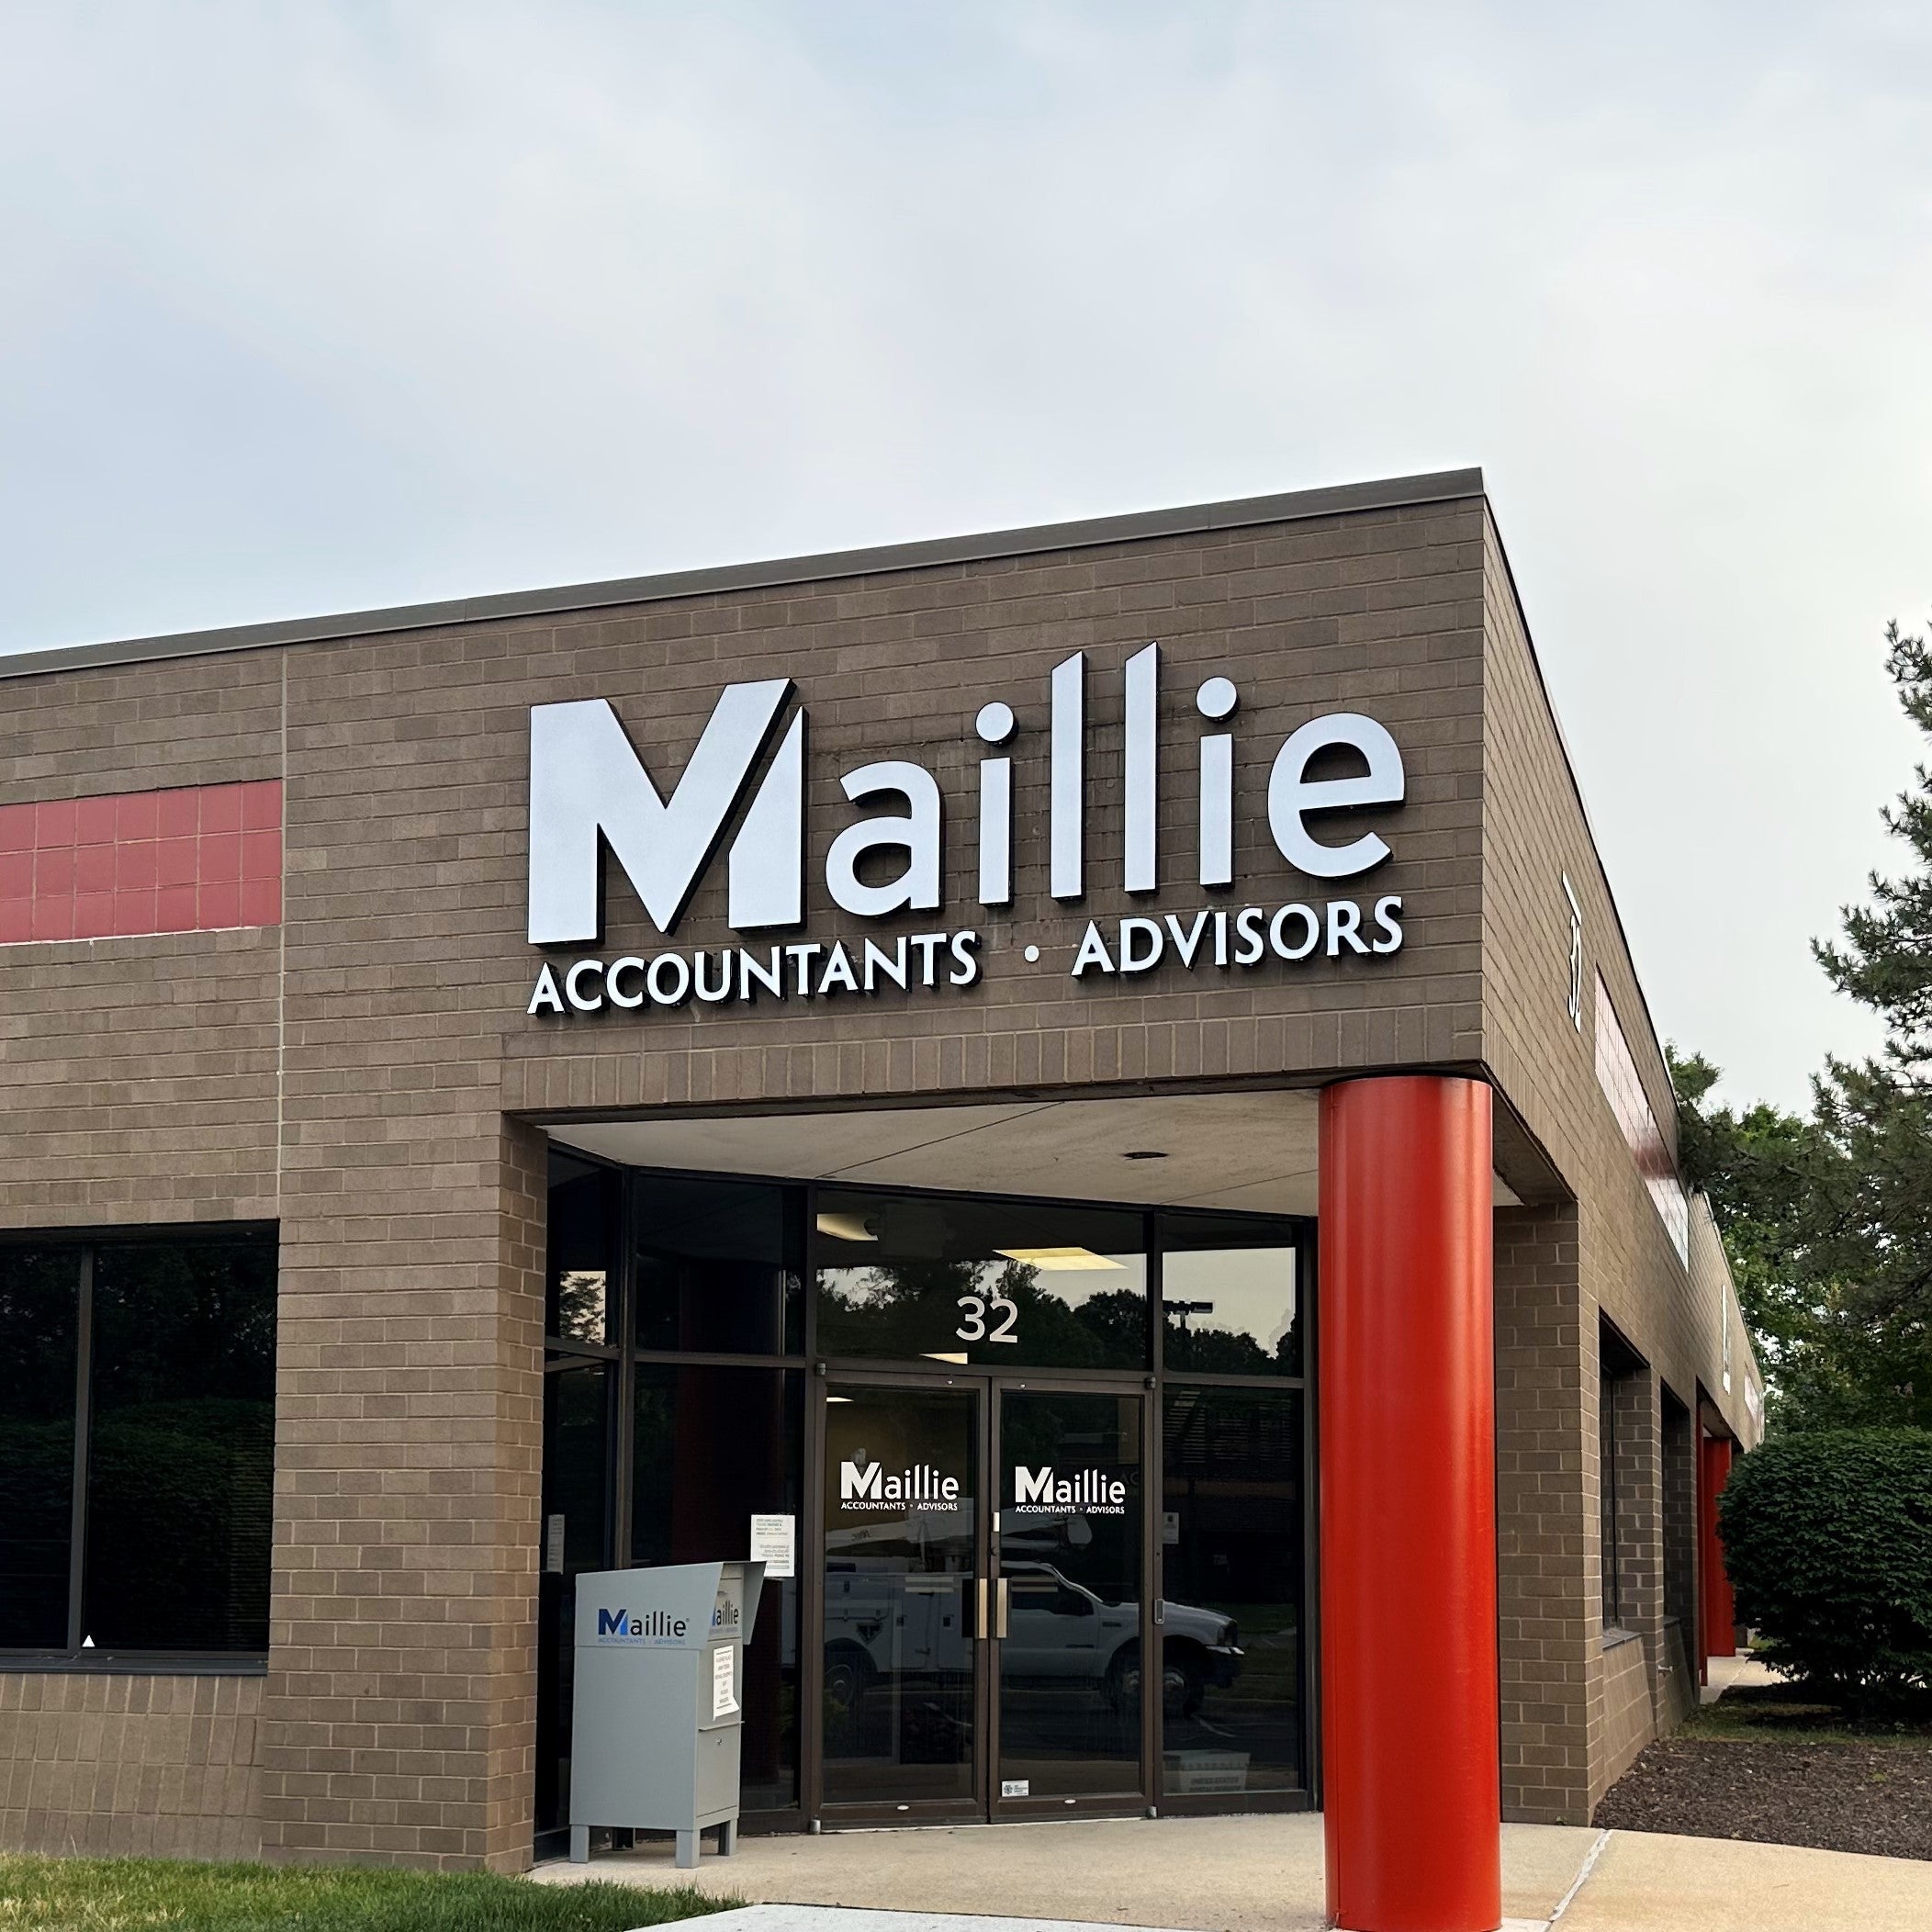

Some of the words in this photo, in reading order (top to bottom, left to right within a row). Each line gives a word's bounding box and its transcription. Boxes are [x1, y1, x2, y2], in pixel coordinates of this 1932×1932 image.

[527, 641, 1405, 943] Maillie
[526, 930, 977, 1015] ACCOUNTANTS
[1071, 895, 1404, 976] ADVISORS
[955, 1296, 1018, 1343] 32
[840, 1461, 960, 1500] Maillie
[1015, 1466, 1126, 1504] Maillie
[840, 1501, 906, 1511] ACCOUNTANTS
[917, 1502, 958, 1511] ADVISORS
[1015, 1505, 1076, 1514] ACCOUNTANTS
[1086, 1506, 1125, 1514] ADVISORS
[598, 1608, 687, 1637] Maillie
